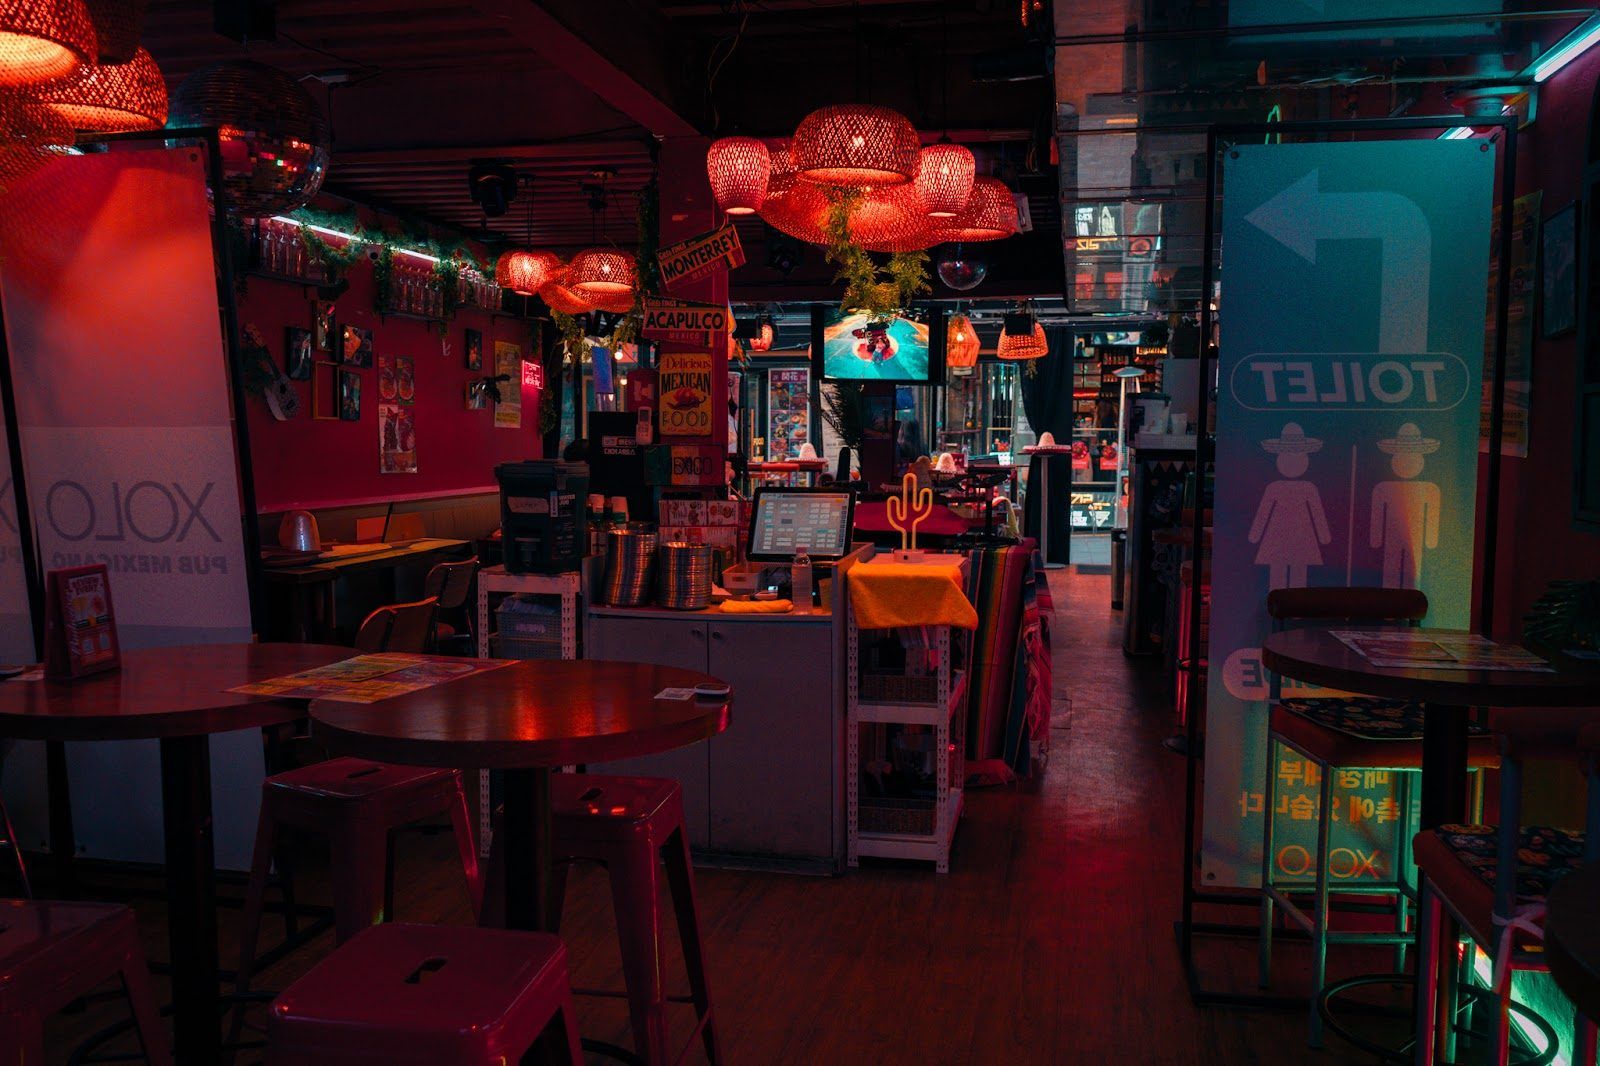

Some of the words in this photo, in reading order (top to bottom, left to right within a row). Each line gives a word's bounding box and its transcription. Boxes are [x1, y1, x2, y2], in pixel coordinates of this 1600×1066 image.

[662, 230, 737, 281] MONTERREY
[646, 311, 724, 329] ACAPULCO
[665, 356, 712, 369] Delicious
[660, 371, 711, 396] MEXICAN
[662, 410, 708, 427] FOOD
